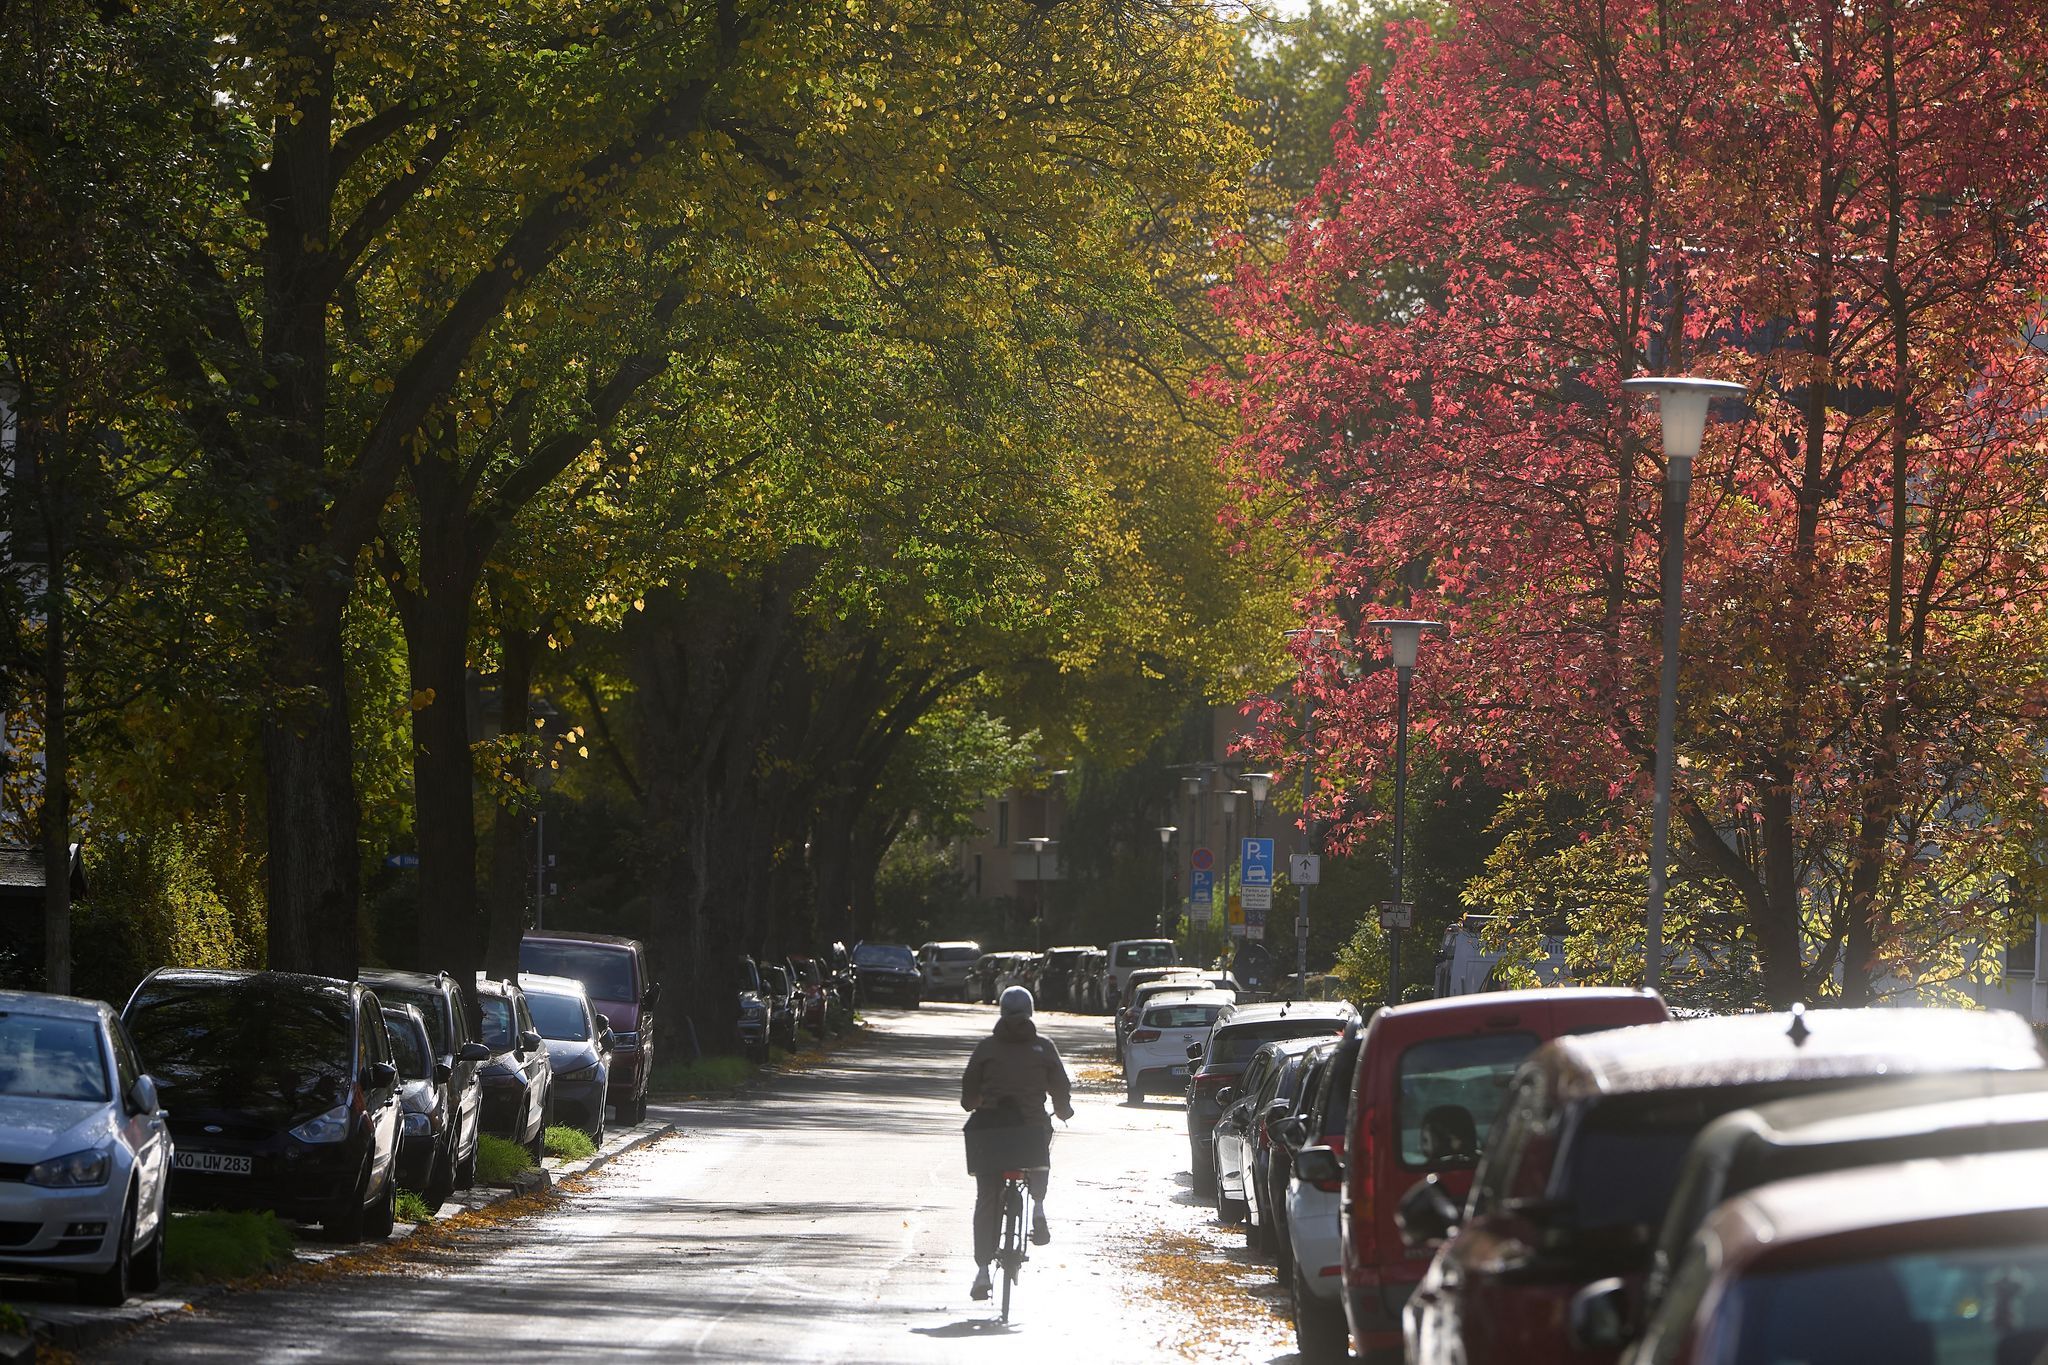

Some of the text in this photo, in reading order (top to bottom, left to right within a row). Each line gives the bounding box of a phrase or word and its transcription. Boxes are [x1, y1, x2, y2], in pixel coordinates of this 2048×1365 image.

[1247, 841, 1260, 860] P
[1194, 872, 1205, 885] P
[176, 1153, 250, 1172] KO UW 283
